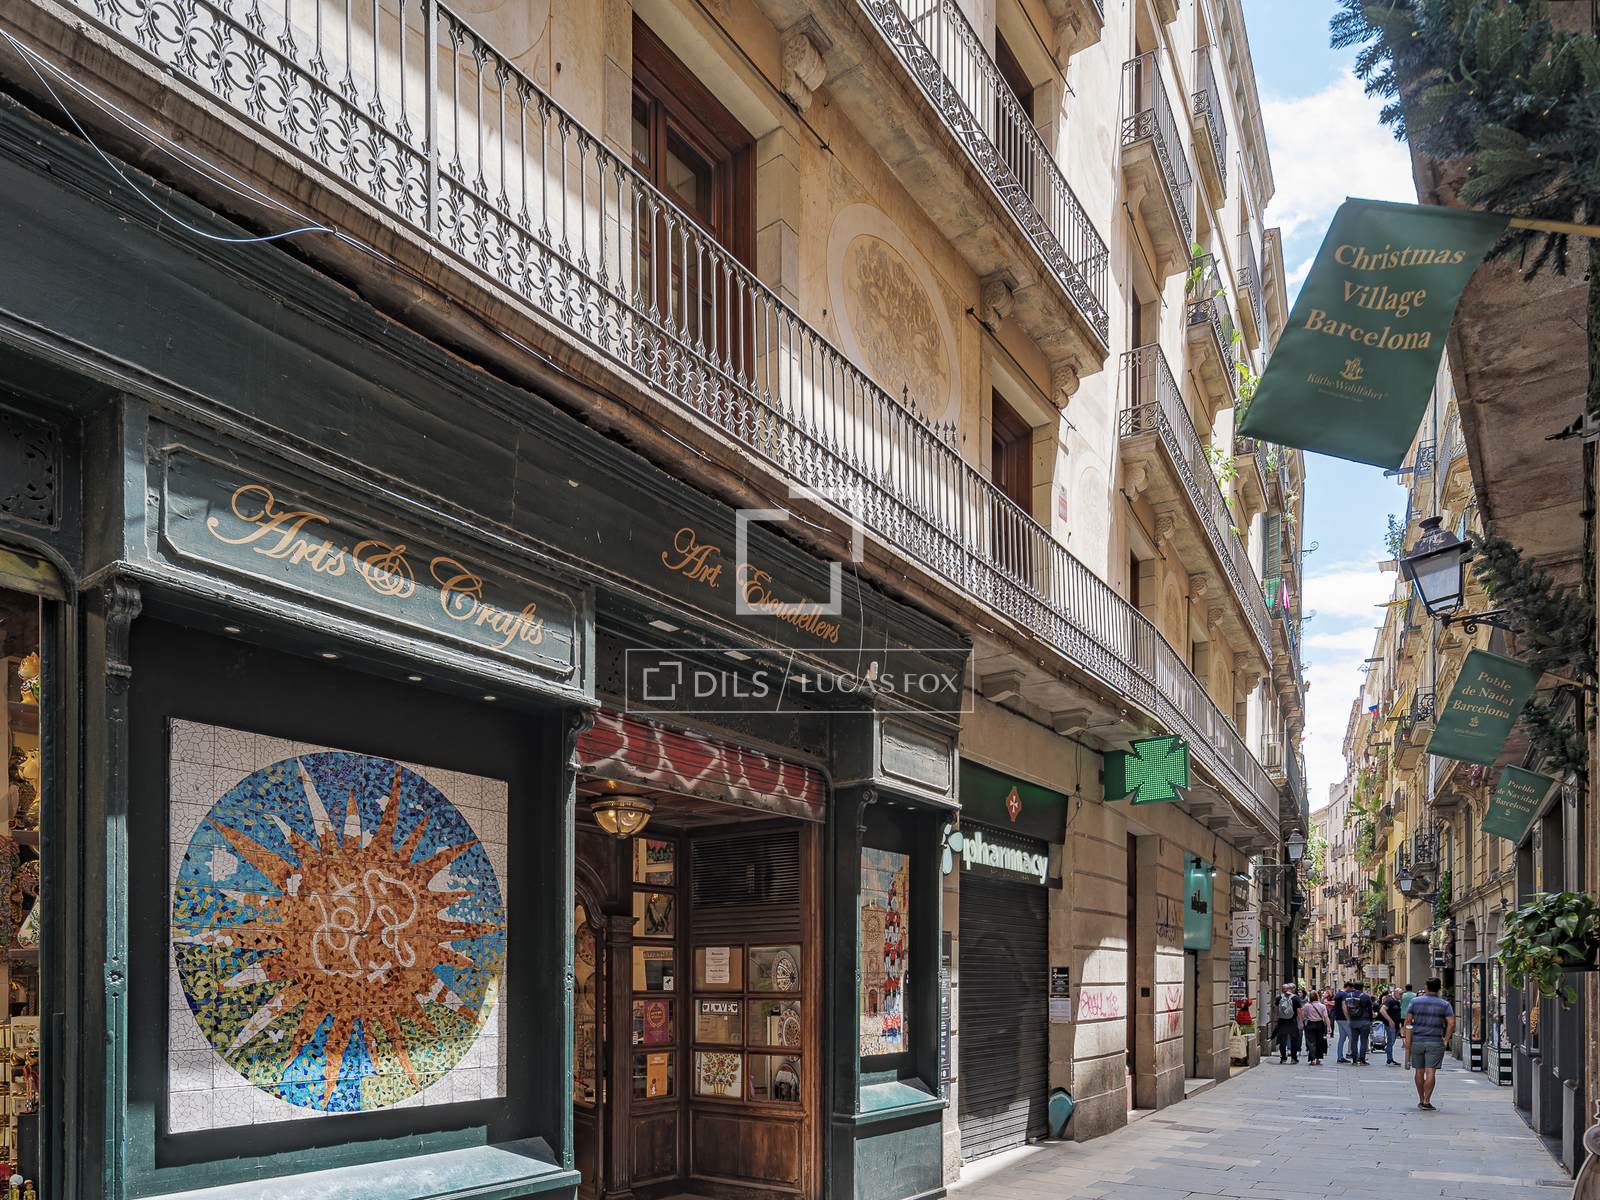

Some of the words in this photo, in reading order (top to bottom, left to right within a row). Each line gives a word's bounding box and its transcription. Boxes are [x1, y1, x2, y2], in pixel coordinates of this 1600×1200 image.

[1334, 243, 1466, 272] Christmas
[1342, 280, 1427, 318] Village
[1303, 309, 1433, 351] Barcelona
[206, 483, 347, 577] Arts
[352, 539, 416, 599] &
[429, 555, 546, 650] Crafts
[735, 562, 841, 644] Escudellers
[1477, 671, 1512, 691] Poble
[1461, 685, 1477, 696] de
[1478, 687, 1515, 707] Nadal
[1452, 699, 1511, 720] Barcelona
[1496, 787, 1506, 795] de
[1505, 789, 1539, 806] Navidad
[1507, 779, 1536, 794] Pueblo
[1495, 797, 1531, 813] Barcelona
[962, 831, 1049, 885] pharmacy
